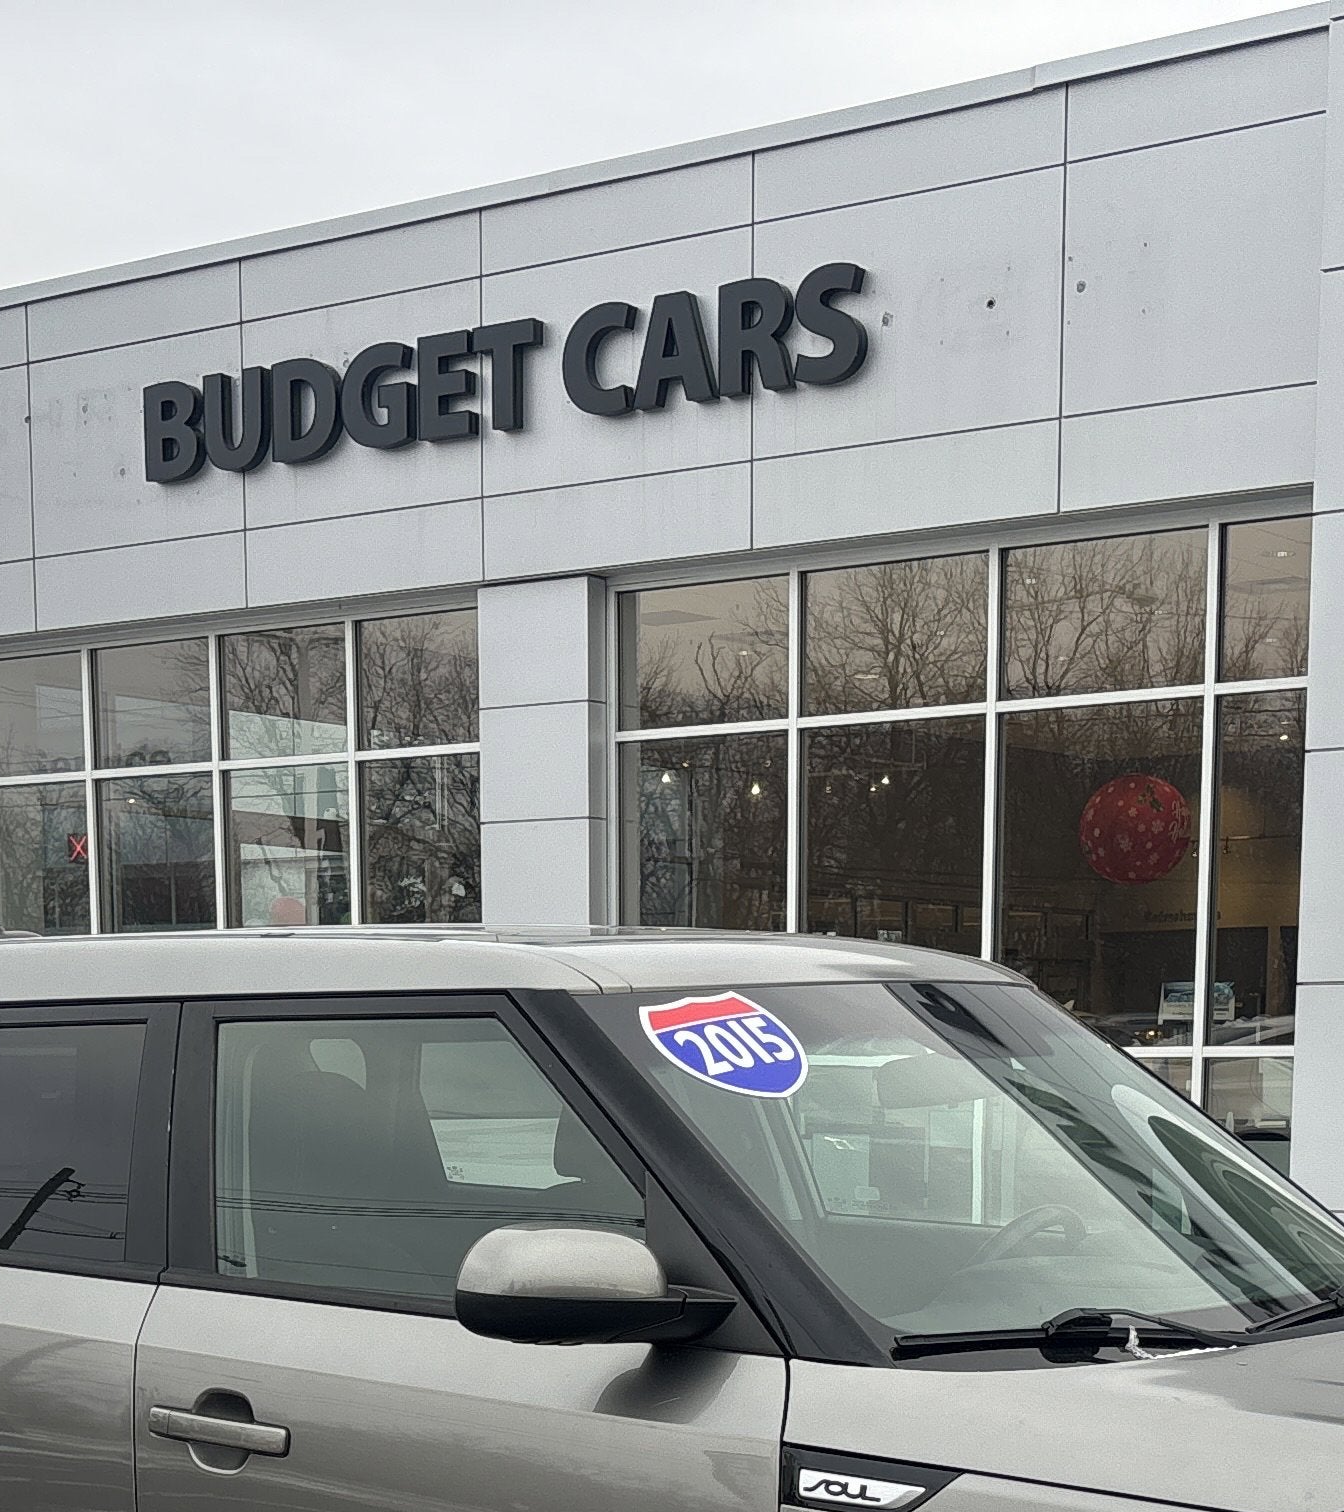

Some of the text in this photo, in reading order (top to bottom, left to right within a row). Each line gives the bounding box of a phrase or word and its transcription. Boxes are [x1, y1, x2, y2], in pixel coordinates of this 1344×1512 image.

[142, 261, 869, 485] BUDGET CARS
[673, 1016, 795, 1076] 2015
